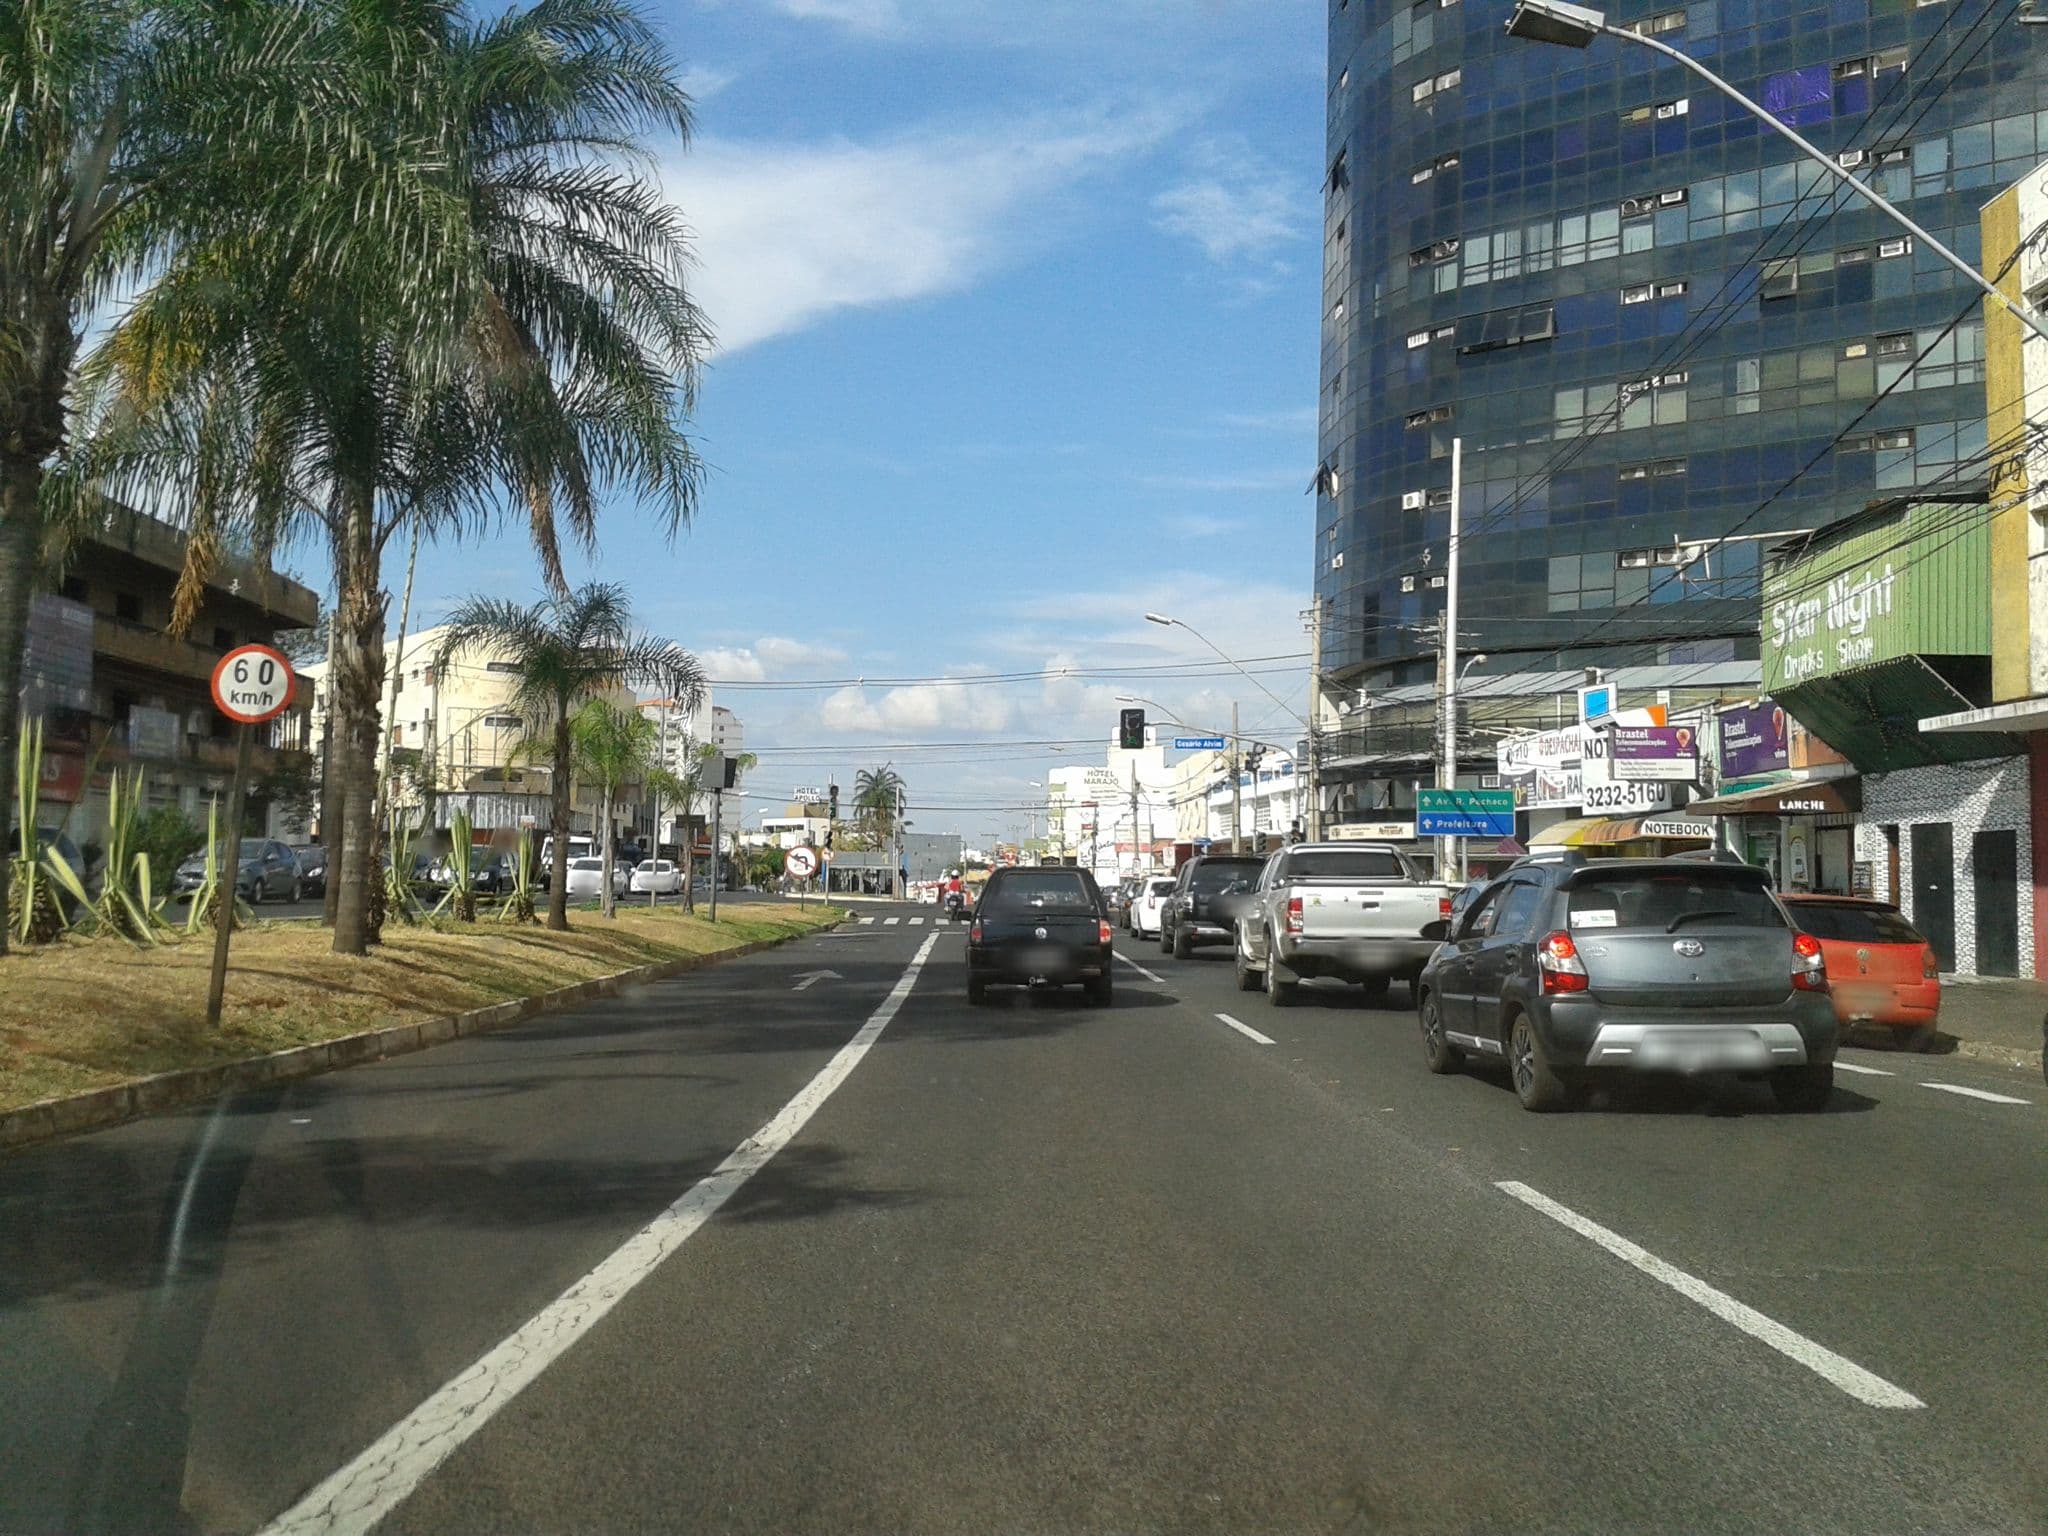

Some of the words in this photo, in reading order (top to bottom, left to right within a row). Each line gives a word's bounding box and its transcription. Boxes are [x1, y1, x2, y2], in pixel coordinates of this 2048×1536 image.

[1772, 598, 1821, 647] Star
[1827, 563, 1895, 635] Night
[1836, 637, 1874, 664] Show
[234, 658, 274, 685] 60
[230, 689, 273, 705] km/h
[1615, 728, 1648, 739] Brastel
[1724, 718, 1746, 737] Brastel
[1436, 797, 1451, 806] Av.
[1455, 797, 1464, 805] R.
[1586, 783, 1665, 807] 3232-5160
[1779, 800, 1825, 810] LANCHE
[1436, 819, 1487, 828] Prefeitura
[1645, 823, 1709, 835] NOTEBOOK
